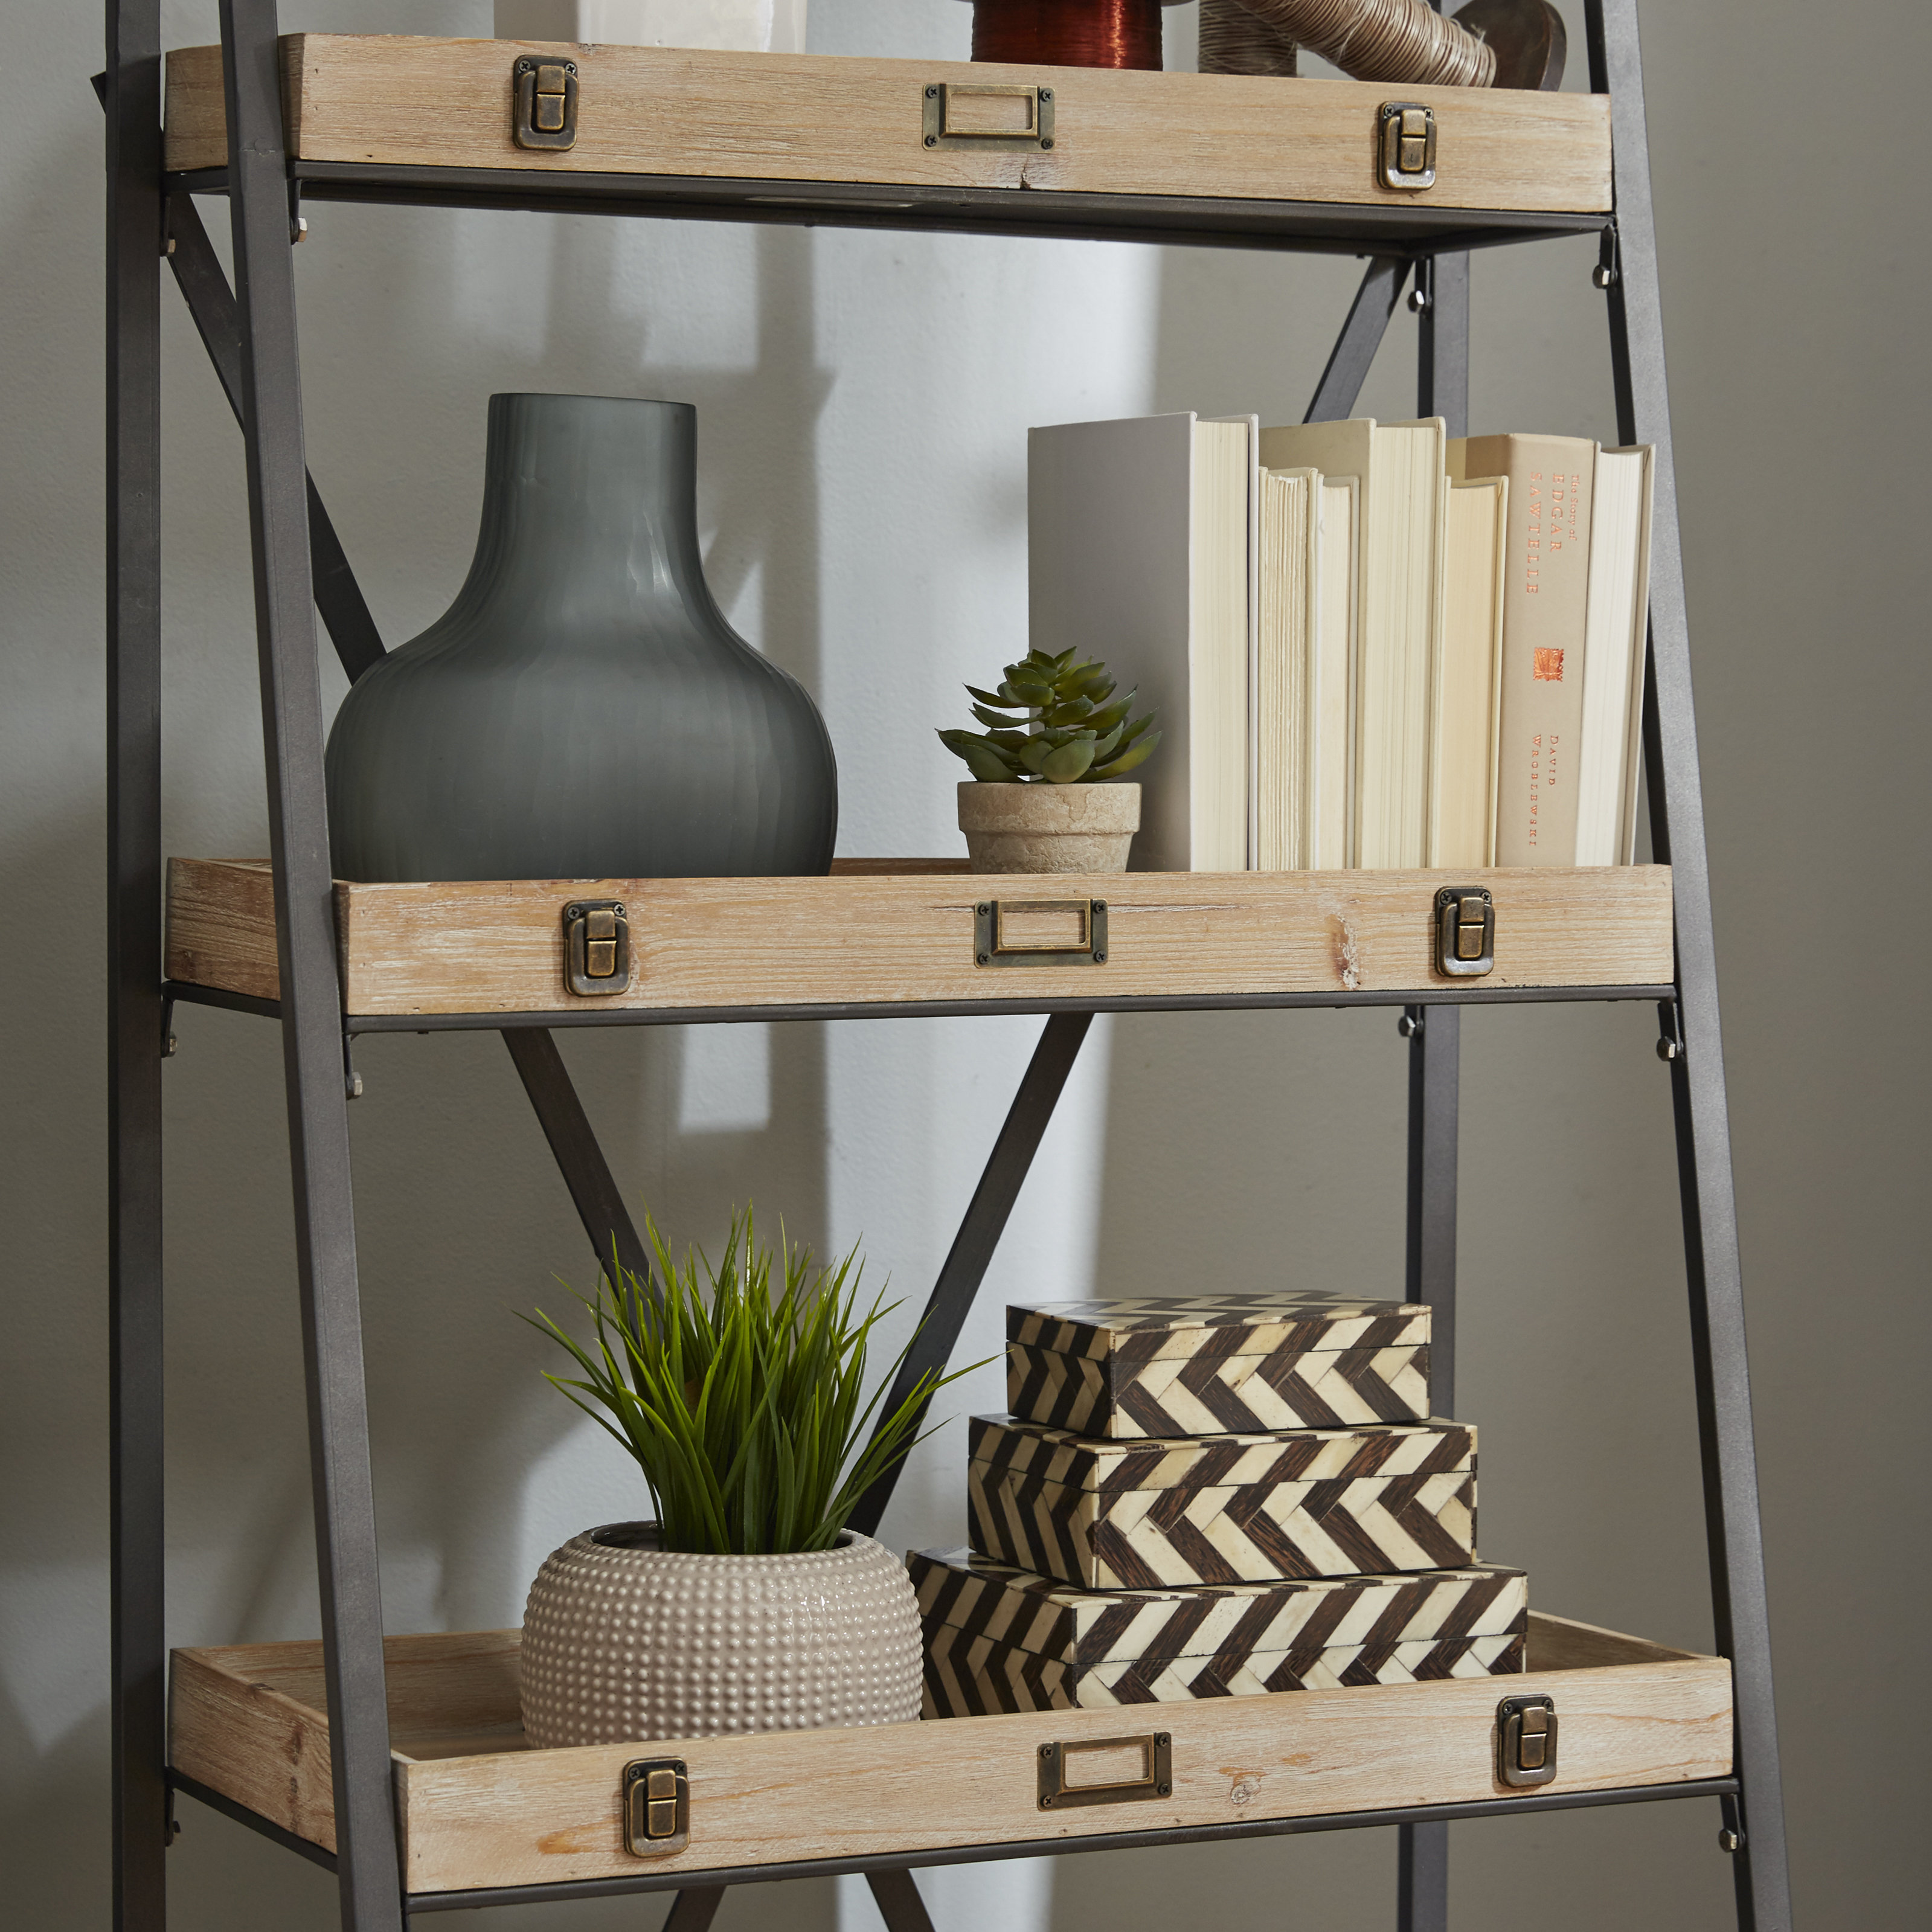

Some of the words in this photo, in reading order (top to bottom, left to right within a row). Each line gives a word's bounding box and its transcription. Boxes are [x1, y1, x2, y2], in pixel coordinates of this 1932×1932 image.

[1571, 474, 1580, 493] The
[1526, 472, 1542, 594] SAWTELLE
[1549, 473, 1564, 553] EDGAR
[1568, 498, 1578, 525] Story
[1569, 529, 1577, 541] of
[1548, 735, 1559, 786] DAVID
[1529, 734, 1541, 846] WROBLEWSKI
